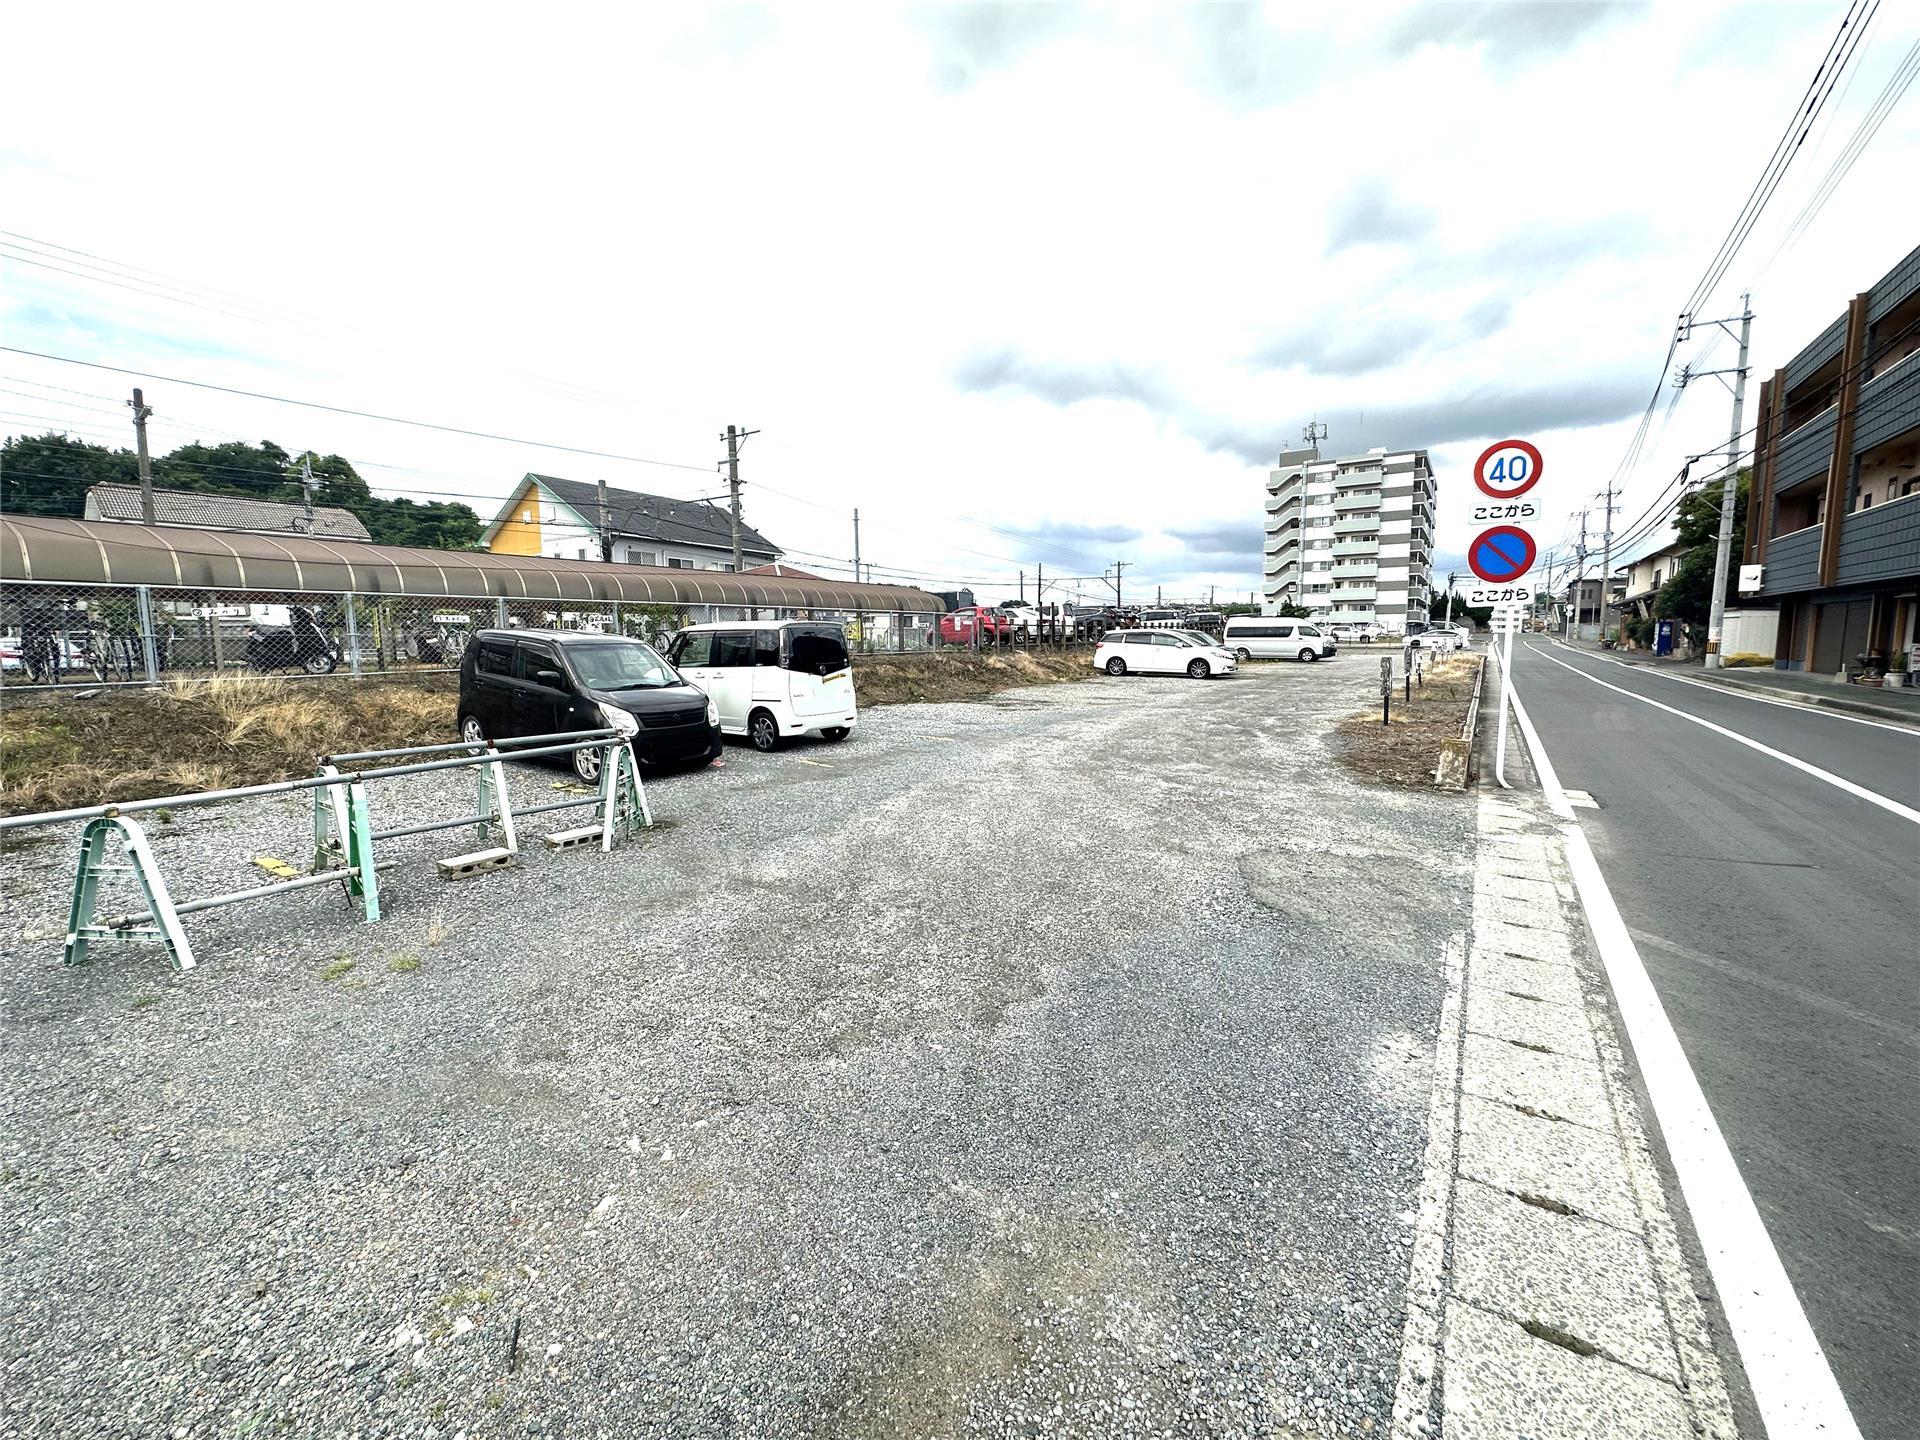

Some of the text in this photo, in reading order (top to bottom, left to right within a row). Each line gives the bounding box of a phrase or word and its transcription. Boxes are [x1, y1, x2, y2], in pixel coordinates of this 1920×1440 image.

[1489, 455, 1527, 482] 40
[1474, 503, 1535, 520] ここから
[1471, 588, 1529, 603] ここから
